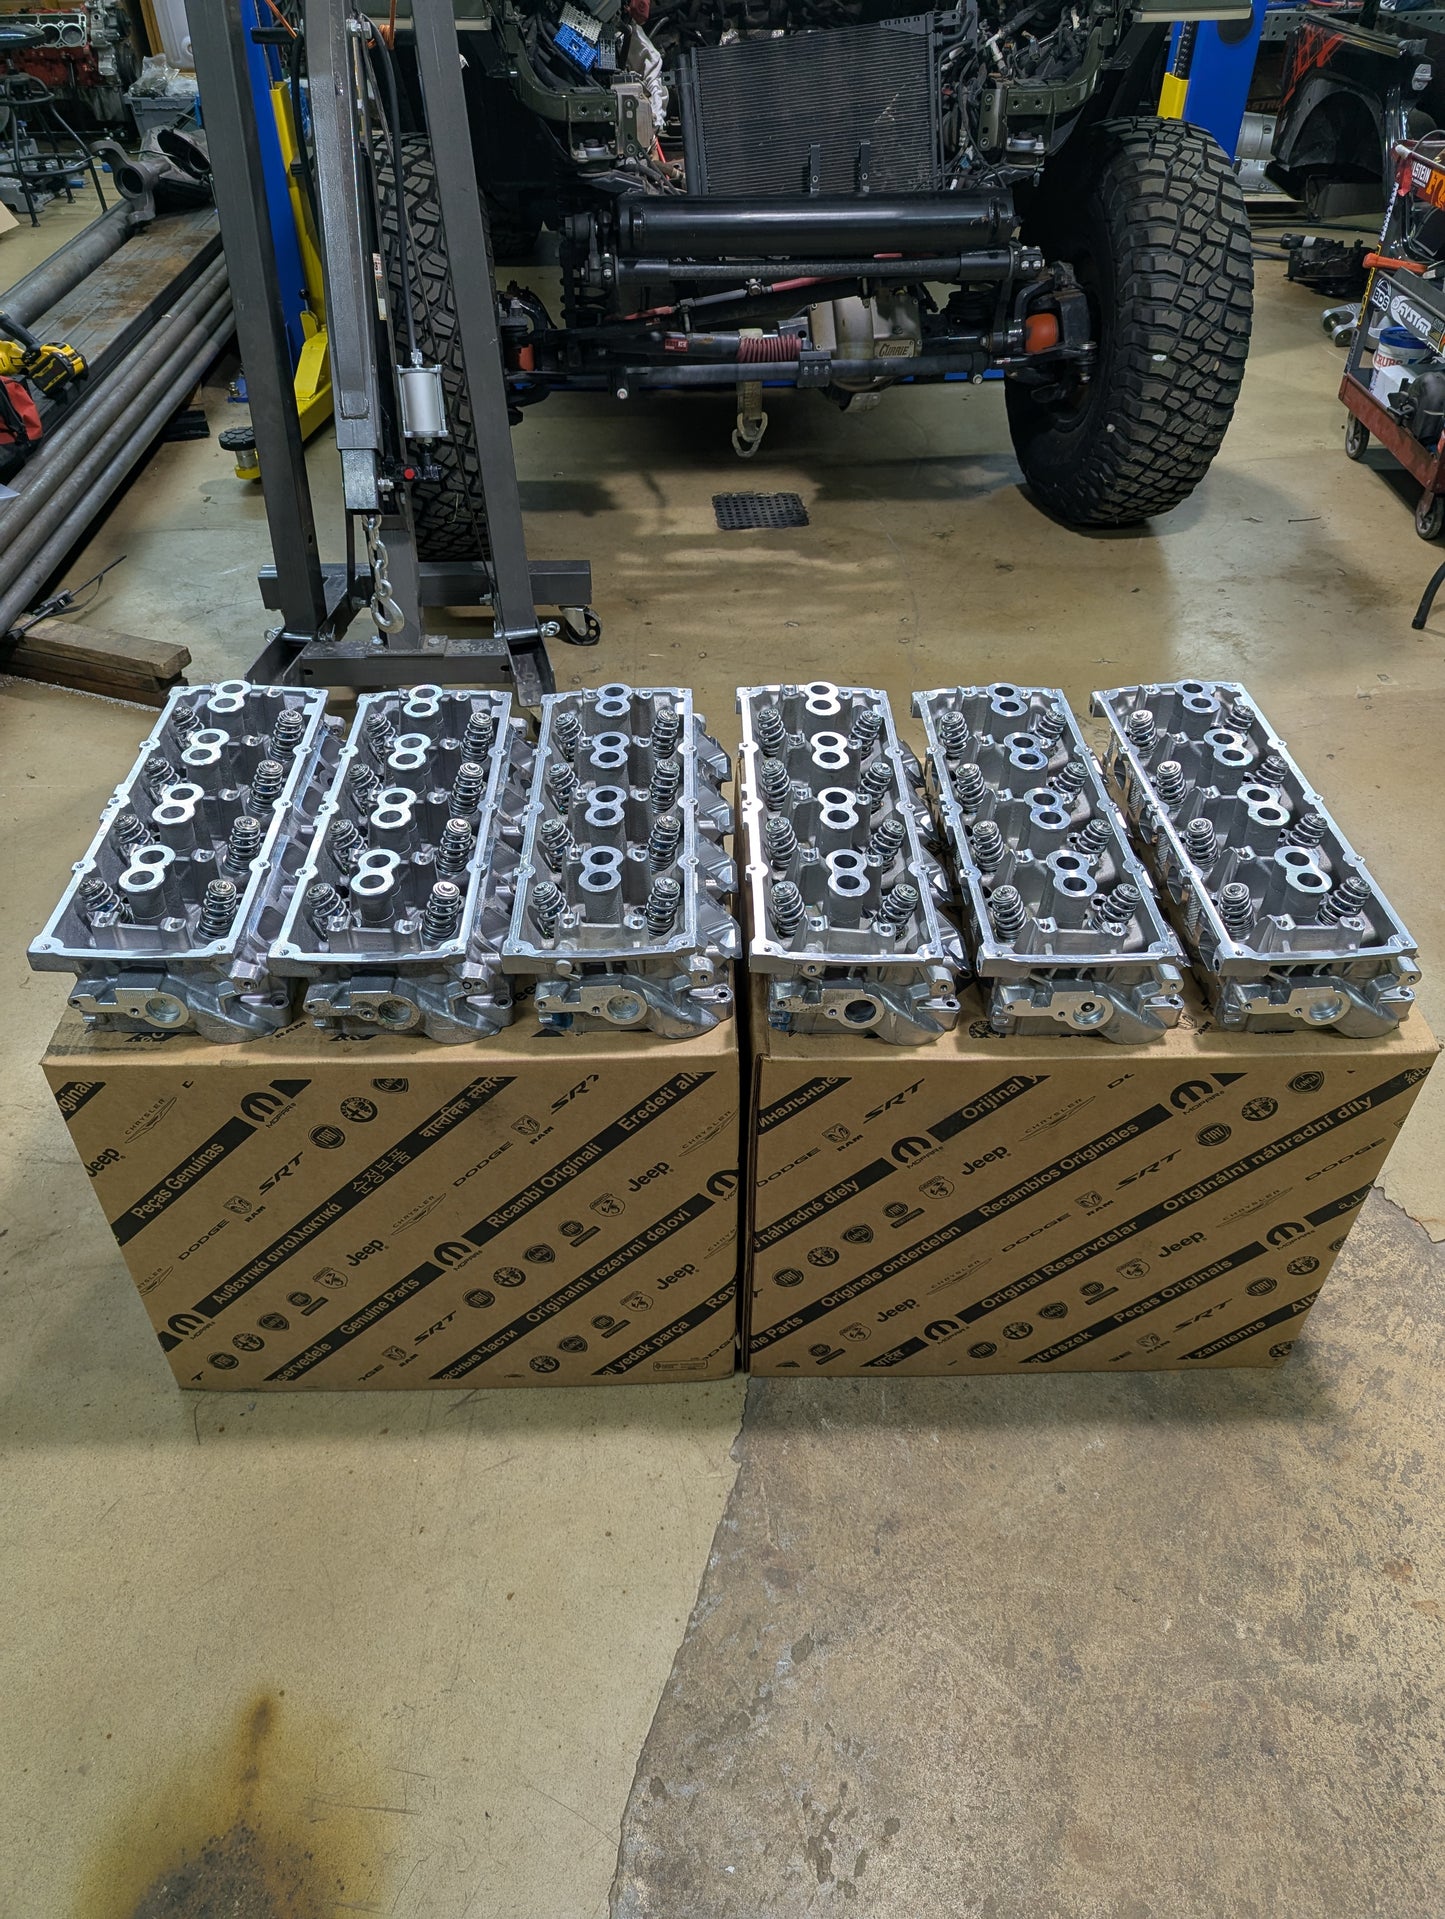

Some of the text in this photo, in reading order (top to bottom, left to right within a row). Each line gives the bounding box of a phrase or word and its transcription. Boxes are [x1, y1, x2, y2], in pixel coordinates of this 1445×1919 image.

[1373, 287, 1390, 311] BDS
[124, 1098, 166, 1135] CHRYSLER
[617, 1087, 677, 1131] Eredeti
[863, 1078, 925, 1124] SRT
[961, 1078, 1025, 1119] Orijinal
[1024, 1098, 1083, 1134] CHRYSLER
[1182, 1093, 1222, 1115] MOPAR
[681, 1110, 732, 1149] CHRYSLER
[1203, 1126, 1225, 1143] FIAT
[259, 1151, 303, 1196] SRT
[352, 1148, 412, 1195] 순정부품
[452, 1126, 554, 1187] DODGE RAM
[756, 1134, 864, 1187] DODGE RAM
[961, 1146, 1008, 1175] Jeep
[979, 1124, 1139, 1217] Recambios Originales
[1115, 1148, 1182, 1191] SRT
[1163, 1160, 1251, 1211] Originální
[1251, 1114, 1335, 1165] náhradní
[1337, 1096, 1373, 1119] díly
[1305, 1137, 1387, 1181] DODGE
[130, 1143, 225, 1219] Peças Genuínas
[486, 1142, 603, 1228] Ricambi Originali
[628, 1161, 670, 1192] Jeep
[392, 1195, 435, 1228] CHRYSLER
[759, 1180, 860, 1244] náhradné diely
[1222, 1189, 1281, 1221] CHRYSLER
[178, 1219, 230, 1260] DODGE
[1002, 1200, 1114, 1252] DODGE RAM
[1158, 1231, 1204, 1258] Jeep
[346, 1239, 384, 1267] Jeep
[525, 1277, 592, 1322] Originalni
[590, 1239, 648, 1281] rezervni
[646, 1208, 691, 1242] delovi
[821, 1271, 883, 1307] Originele
[883, 1226, 961, 1273] onderdelen
[981, 1221, 1138, 1309] Original Reservdelar
[656, 1263, 695, 1290] Jeep
[931, 1260, 980, 1289] CHRYSLER
[1113, 1260, 1233, 1323] Peças Originais
[340, 1300, 390, 1335] Genuine
[383, 1279, 420, 1303] Parts
[767, 1316, 804, 1338] Parts
[877, 1299, 917, 1323] Jeep
[1172, 1299, 1233, 1333] SRT
[414, 1311, 457, 1346] SRT
[477, 1329, 518, 1355] Части
[617, 1343, 655, 1368] yedek
[651, 1320, 690, 1347] parça
[1193, 1322, 1266, 1359] zamienne
